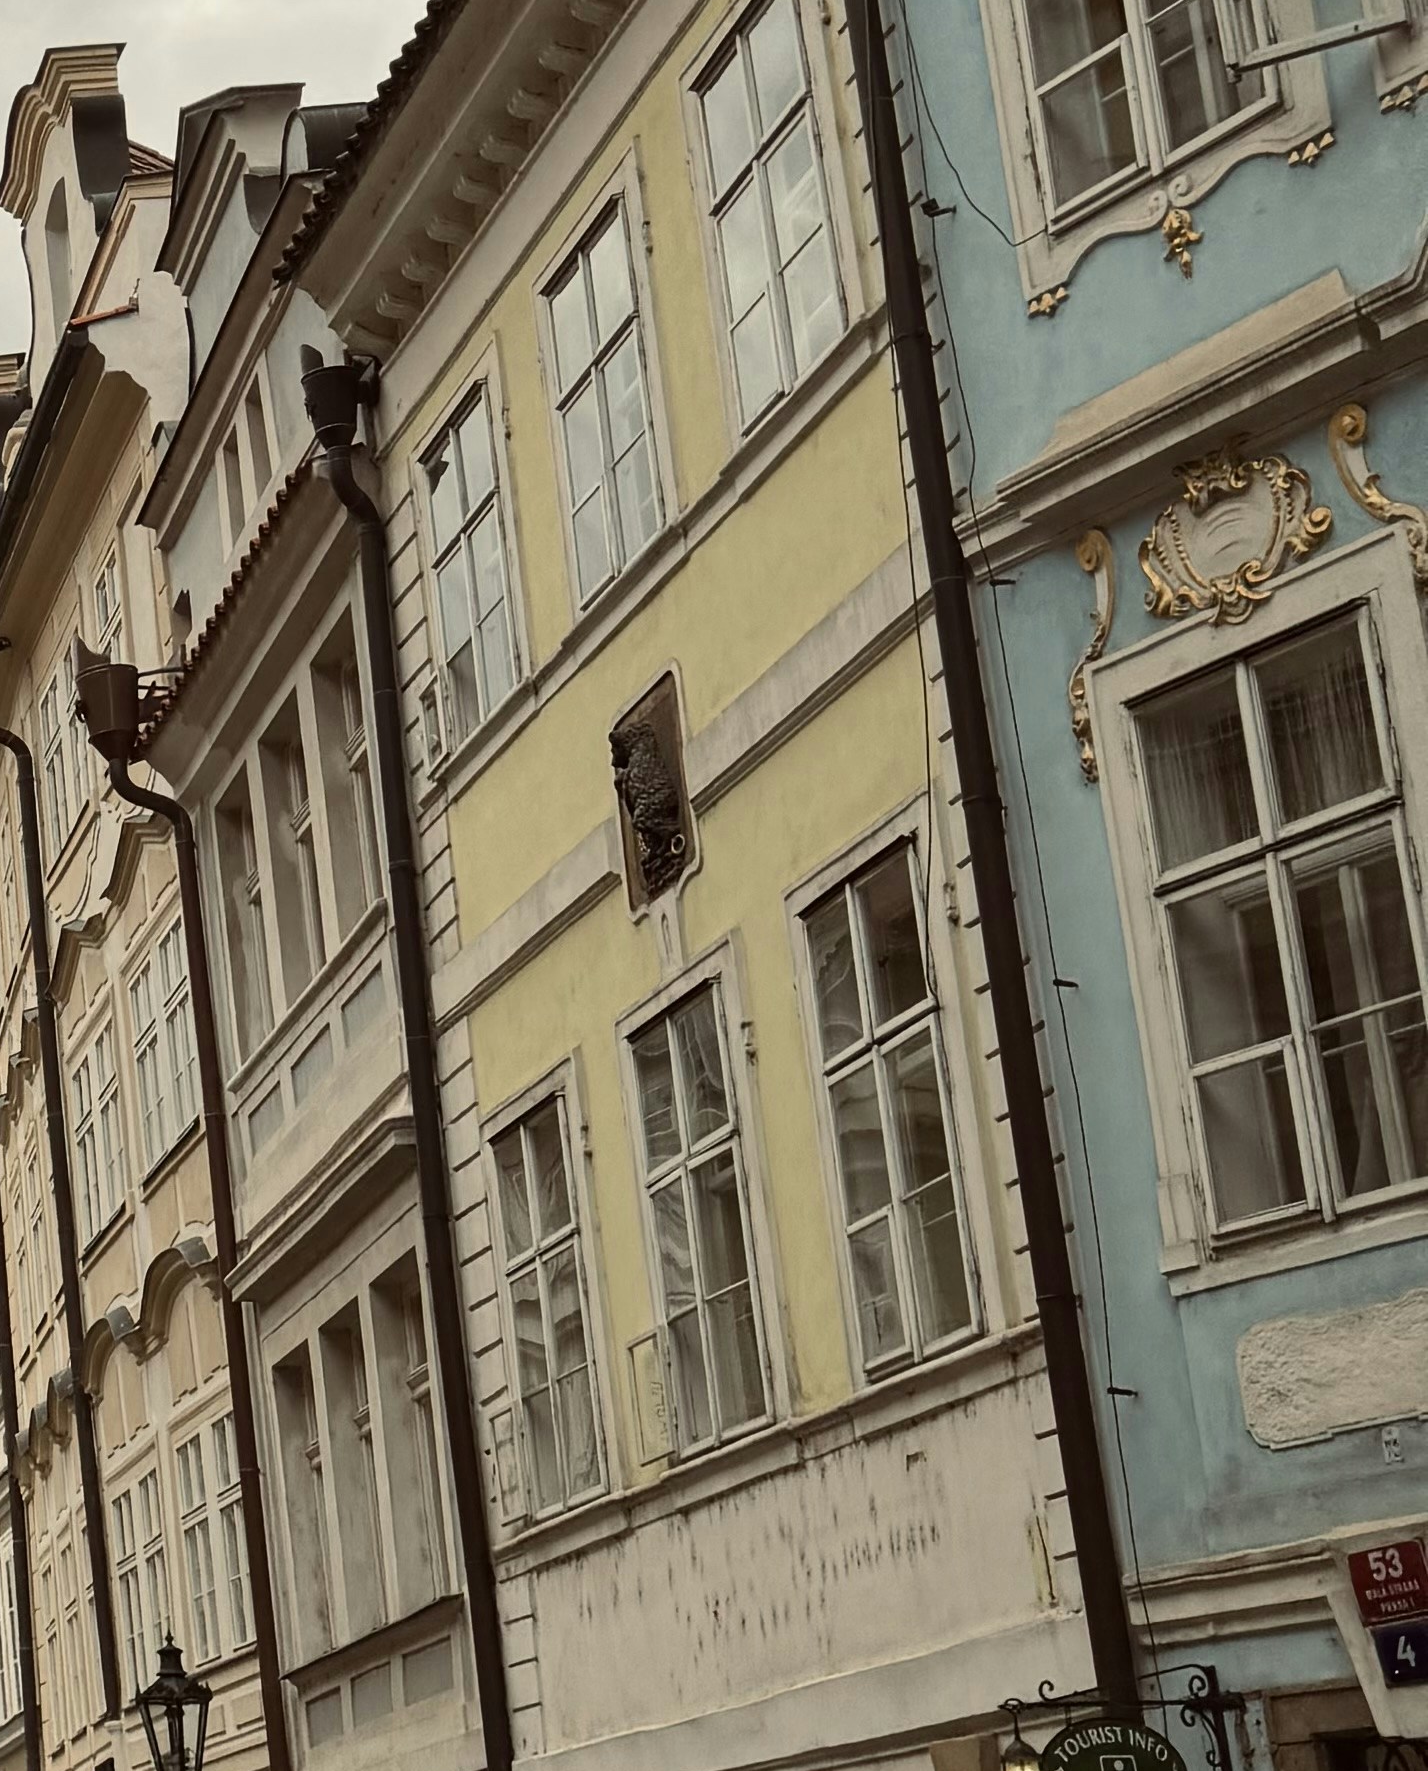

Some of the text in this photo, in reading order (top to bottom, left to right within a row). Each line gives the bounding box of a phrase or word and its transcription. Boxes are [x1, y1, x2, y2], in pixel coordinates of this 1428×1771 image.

[1368, 1548, 1403, 1581] 53
[1397, 1635, 1415, 1667] 4
[1054, 1726, 1168, 1763] TOURIST INFO
